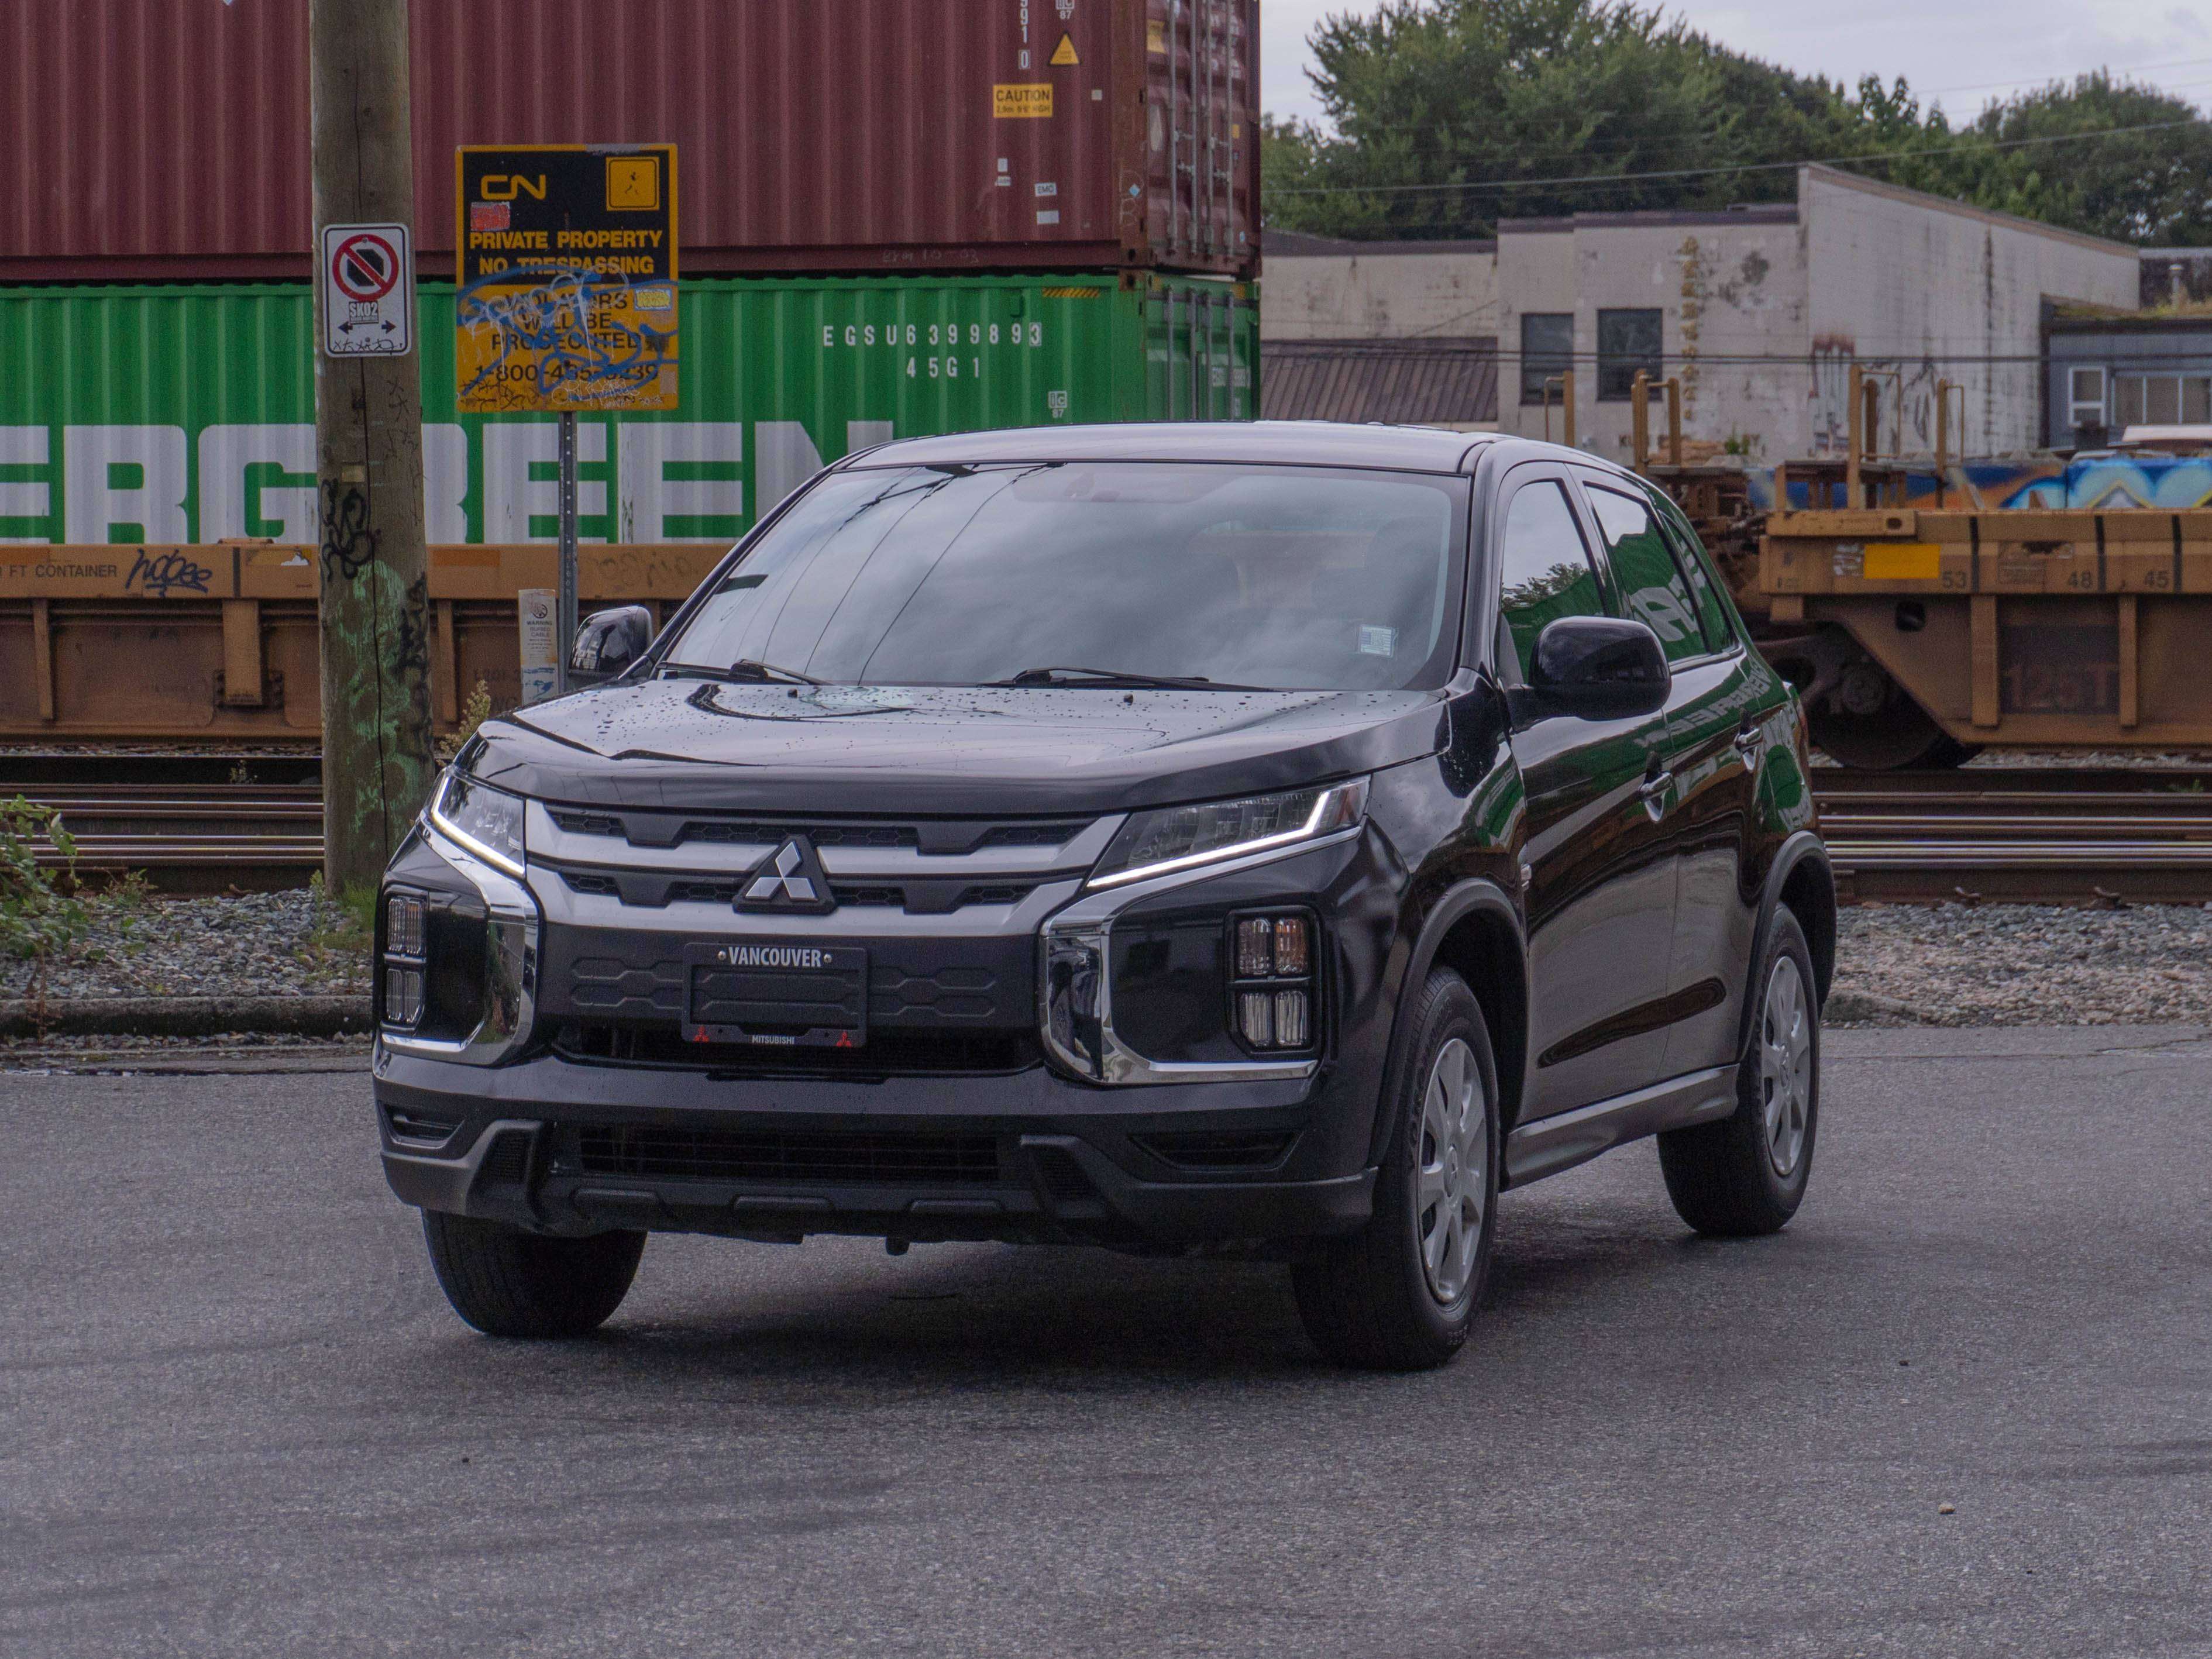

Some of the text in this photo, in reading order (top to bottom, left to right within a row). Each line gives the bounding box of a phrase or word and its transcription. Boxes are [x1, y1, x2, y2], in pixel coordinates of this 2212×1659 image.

[1059, 11, 1072, 19] 87
[481, 174, 546, 201] CN
[470, 230, 663, 249] PRIVATE PROPERTY
[479, 256, 655, 275] NO TRESPASSING
[586, 312, 612, 329] BE
[1052, 409, 1064, 418] 87
[9, 565, 26, 577] FT
[35, 565, 117, 578] CONTAINER
[1942, 571, 1967, 588] 53
[2068, 570, 2093, 588] 48
[2145, 570, 2169, 588] 45
[728, 946, 822, 967] VANCOUVER
[752, 1035, 795, 1045] MITSUBISHI
